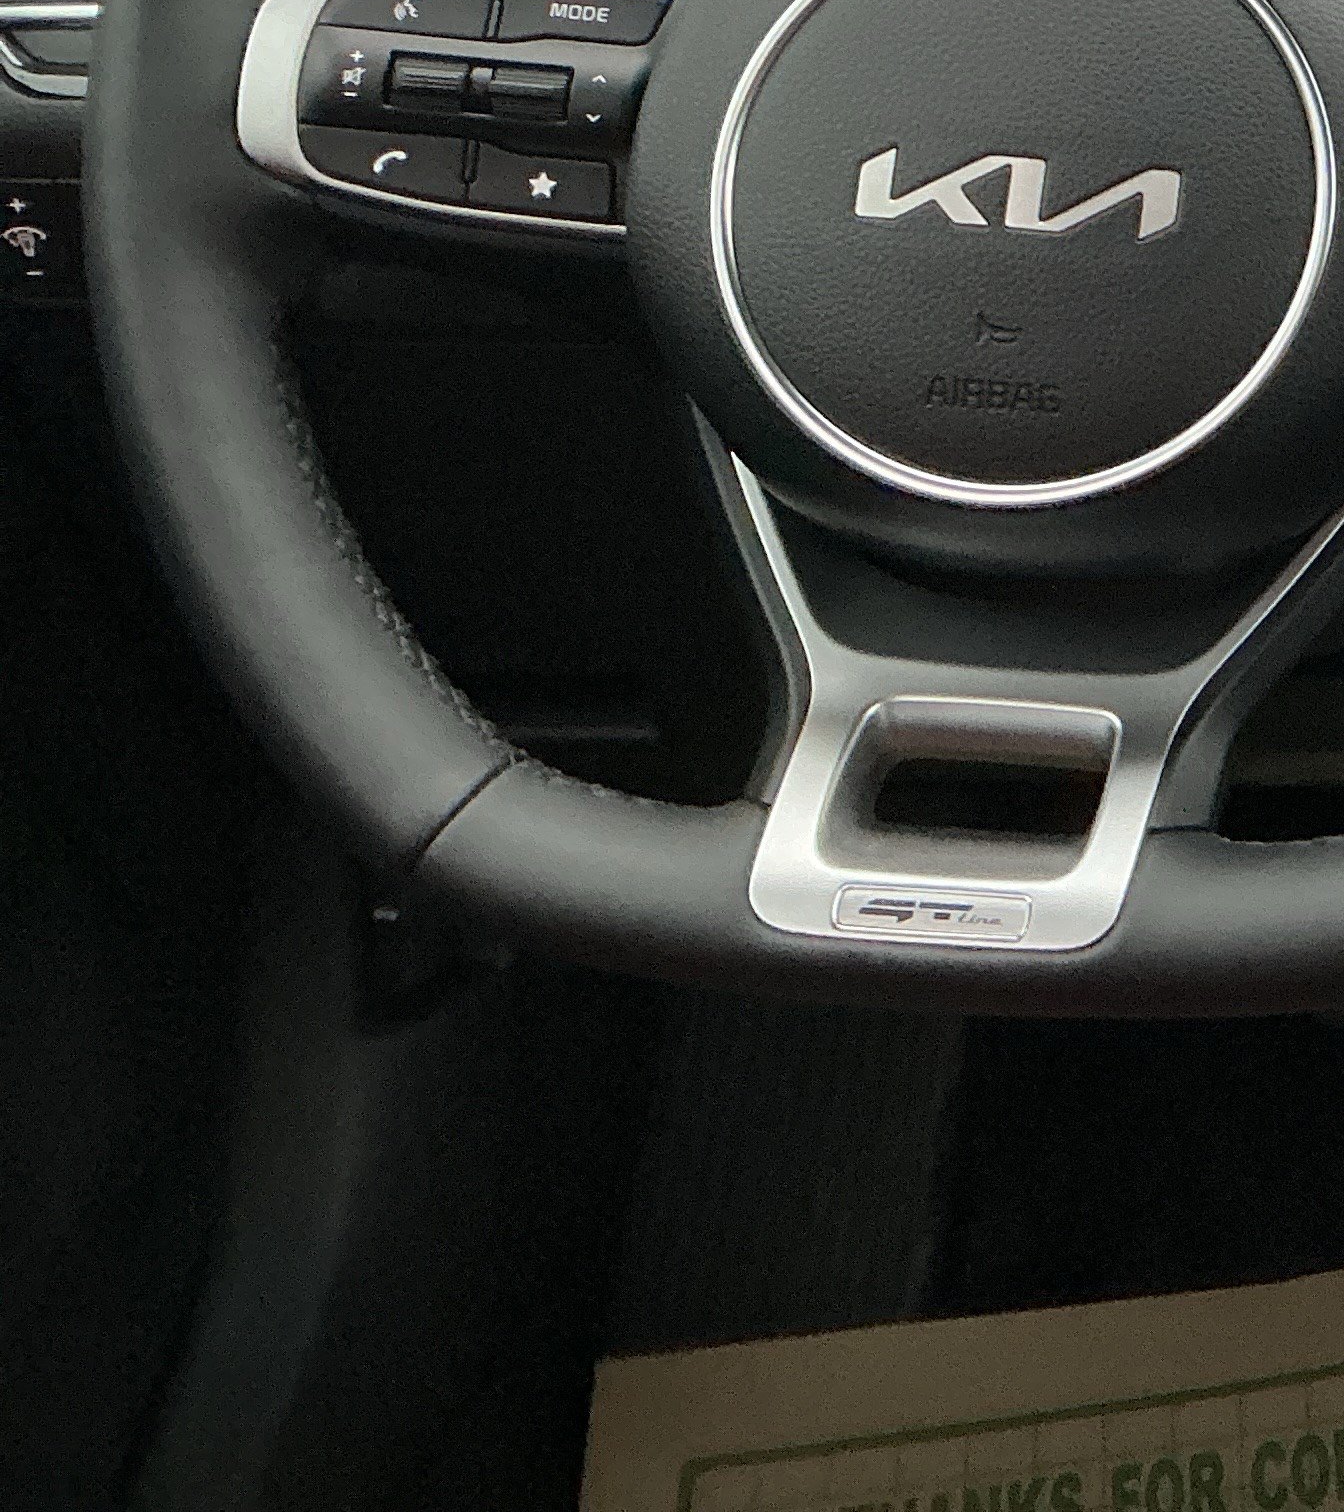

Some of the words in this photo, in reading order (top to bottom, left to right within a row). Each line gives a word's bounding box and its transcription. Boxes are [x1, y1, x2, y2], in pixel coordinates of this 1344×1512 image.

[548, 2, 610, 24] MODE
[926, 375, 1060, 413] AIRBAG
[1111, 1450, 1227, 1512] FOR
